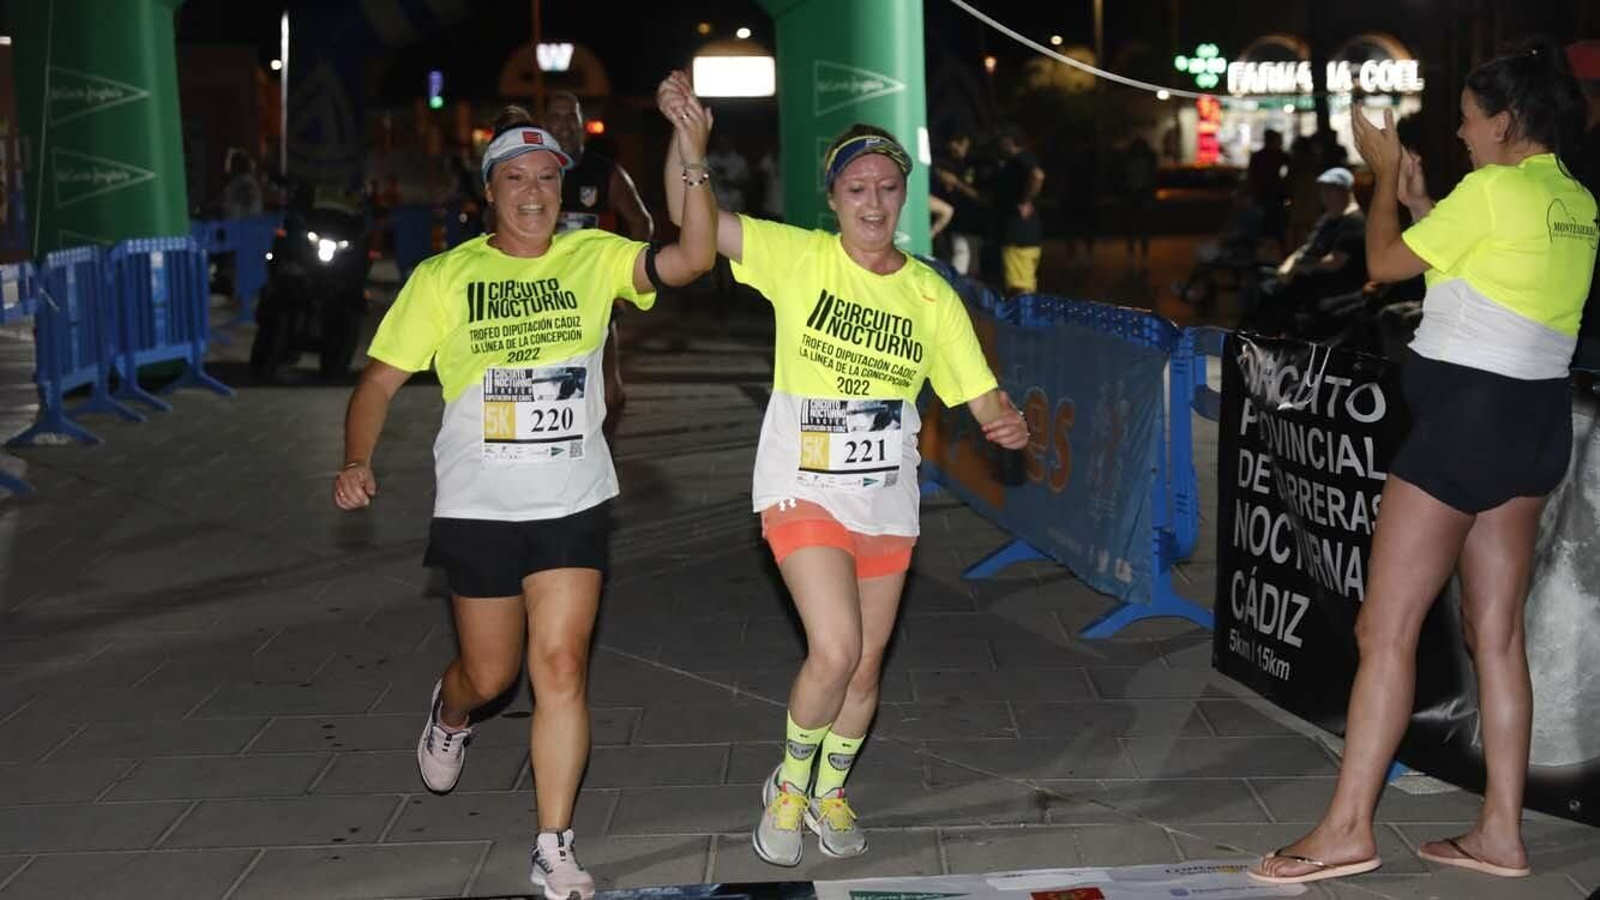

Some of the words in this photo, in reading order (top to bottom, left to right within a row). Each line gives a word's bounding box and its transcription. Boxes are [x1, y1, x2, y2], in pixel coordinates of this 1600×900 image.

[488, 278, 560, 301] CIRCUITO
[487, 290, 578, 320] NOCTURNO
[833, 298, 913, 338] CIRCUITO
[469, 326, 500, 342] TROFEO
[502, 317, 553, 337] DIPUTACIÓN
[554, 315, 582, 328] CÁDIZ
[471, 342, 481, 354] LA
[506, 338, 517, 349] DE
[518, 335, 529, 347] LA
[530, 329, 582, 345] CONCEPCIÓN
[825, 315, 923, 364] NOCTURNO
[507, 347, 541, 363] 2022
[799, 346, 809, 359] LA
[810, 350, 834, 370] LÍNEA
[835, 361, 847, 374] DE
[848, 364, 860, 377] LA
[801, 333, 835, 356] TROFEO
[835, 347, 891, 372] DIPUTACIÓN
[891, 364, 917, 380] CÁDIZ
[836, 376, 870, 396] 2022
[531, 406, 574, 432] 220
[844, 438, 885, 463] 221
[1239, 398, 1387, 480] POVINCIAL
[1238, 449, 1271, 494] DE
[1231, 566, 1310, 648] CÁDIZ
[1229, 628, 1250, 662] 5km
[1256, 643, 1291, 681] 15km
